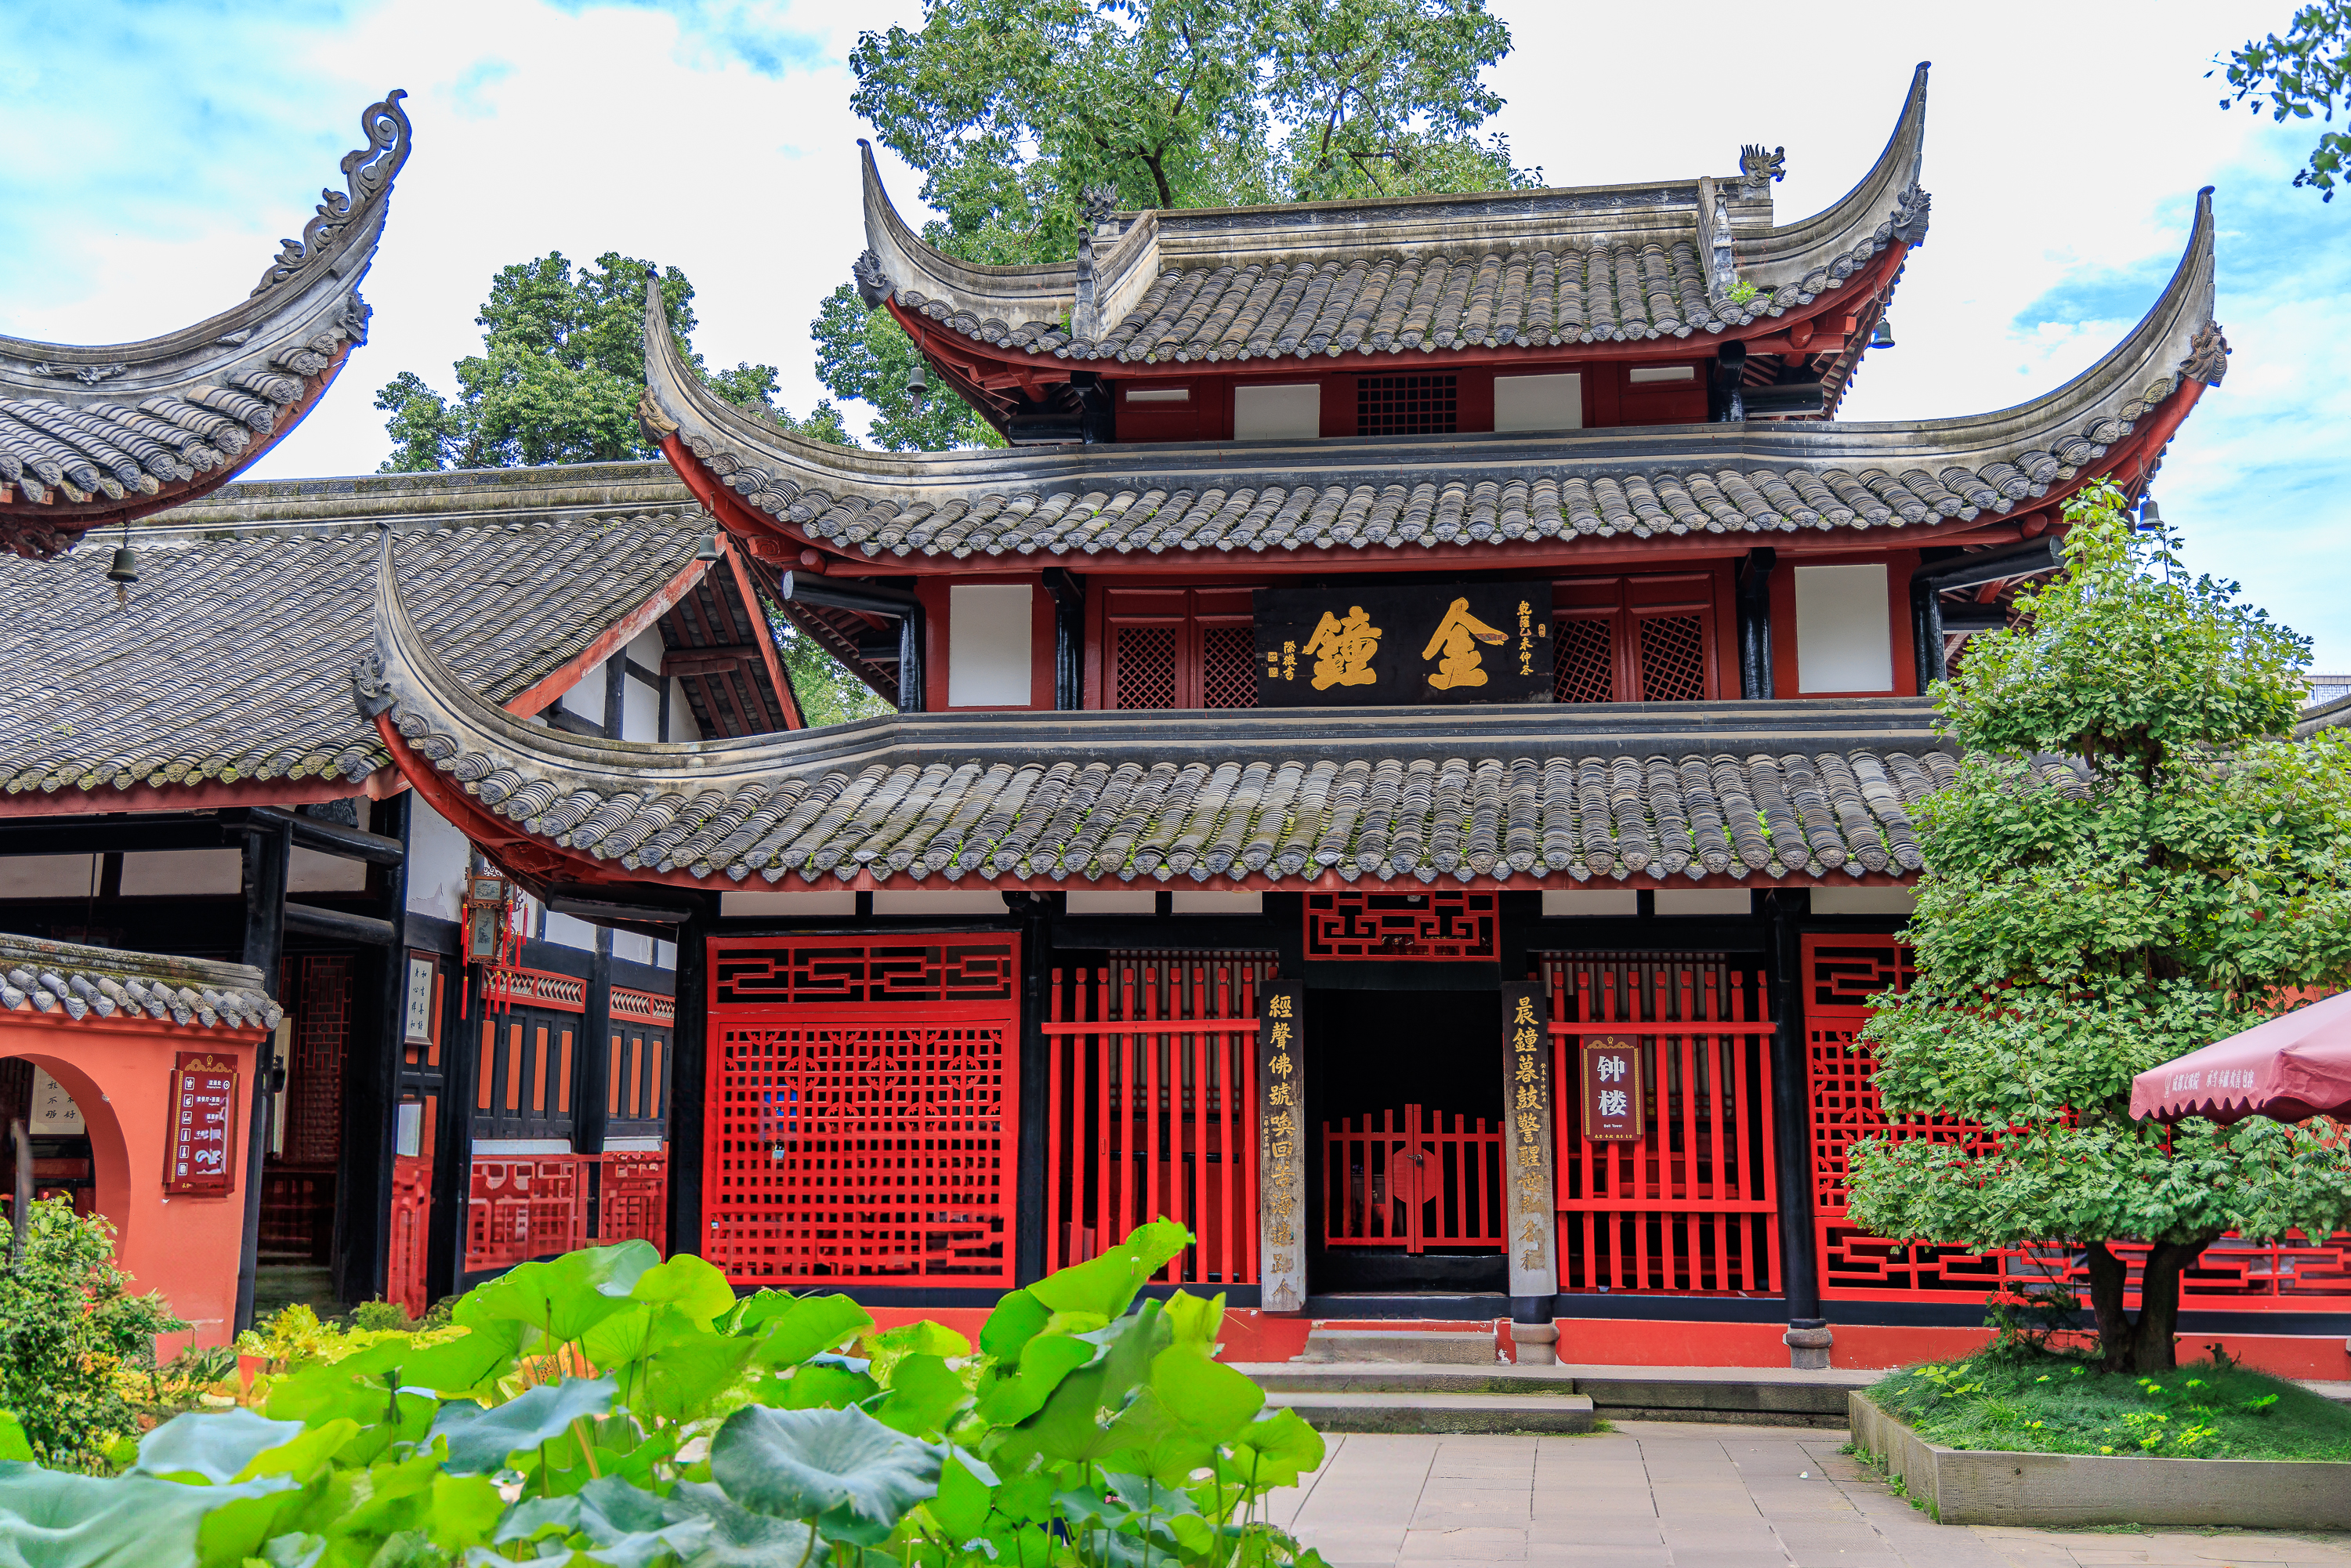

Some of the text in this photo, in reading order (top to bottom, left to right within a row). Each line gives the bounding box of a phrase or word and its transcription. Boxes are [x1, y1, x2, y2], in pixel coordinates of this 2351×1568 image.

[1596, 1056, 1627, 1116] 钟楼
[2172, 1071, 2201, 1092] 成都文殊院
